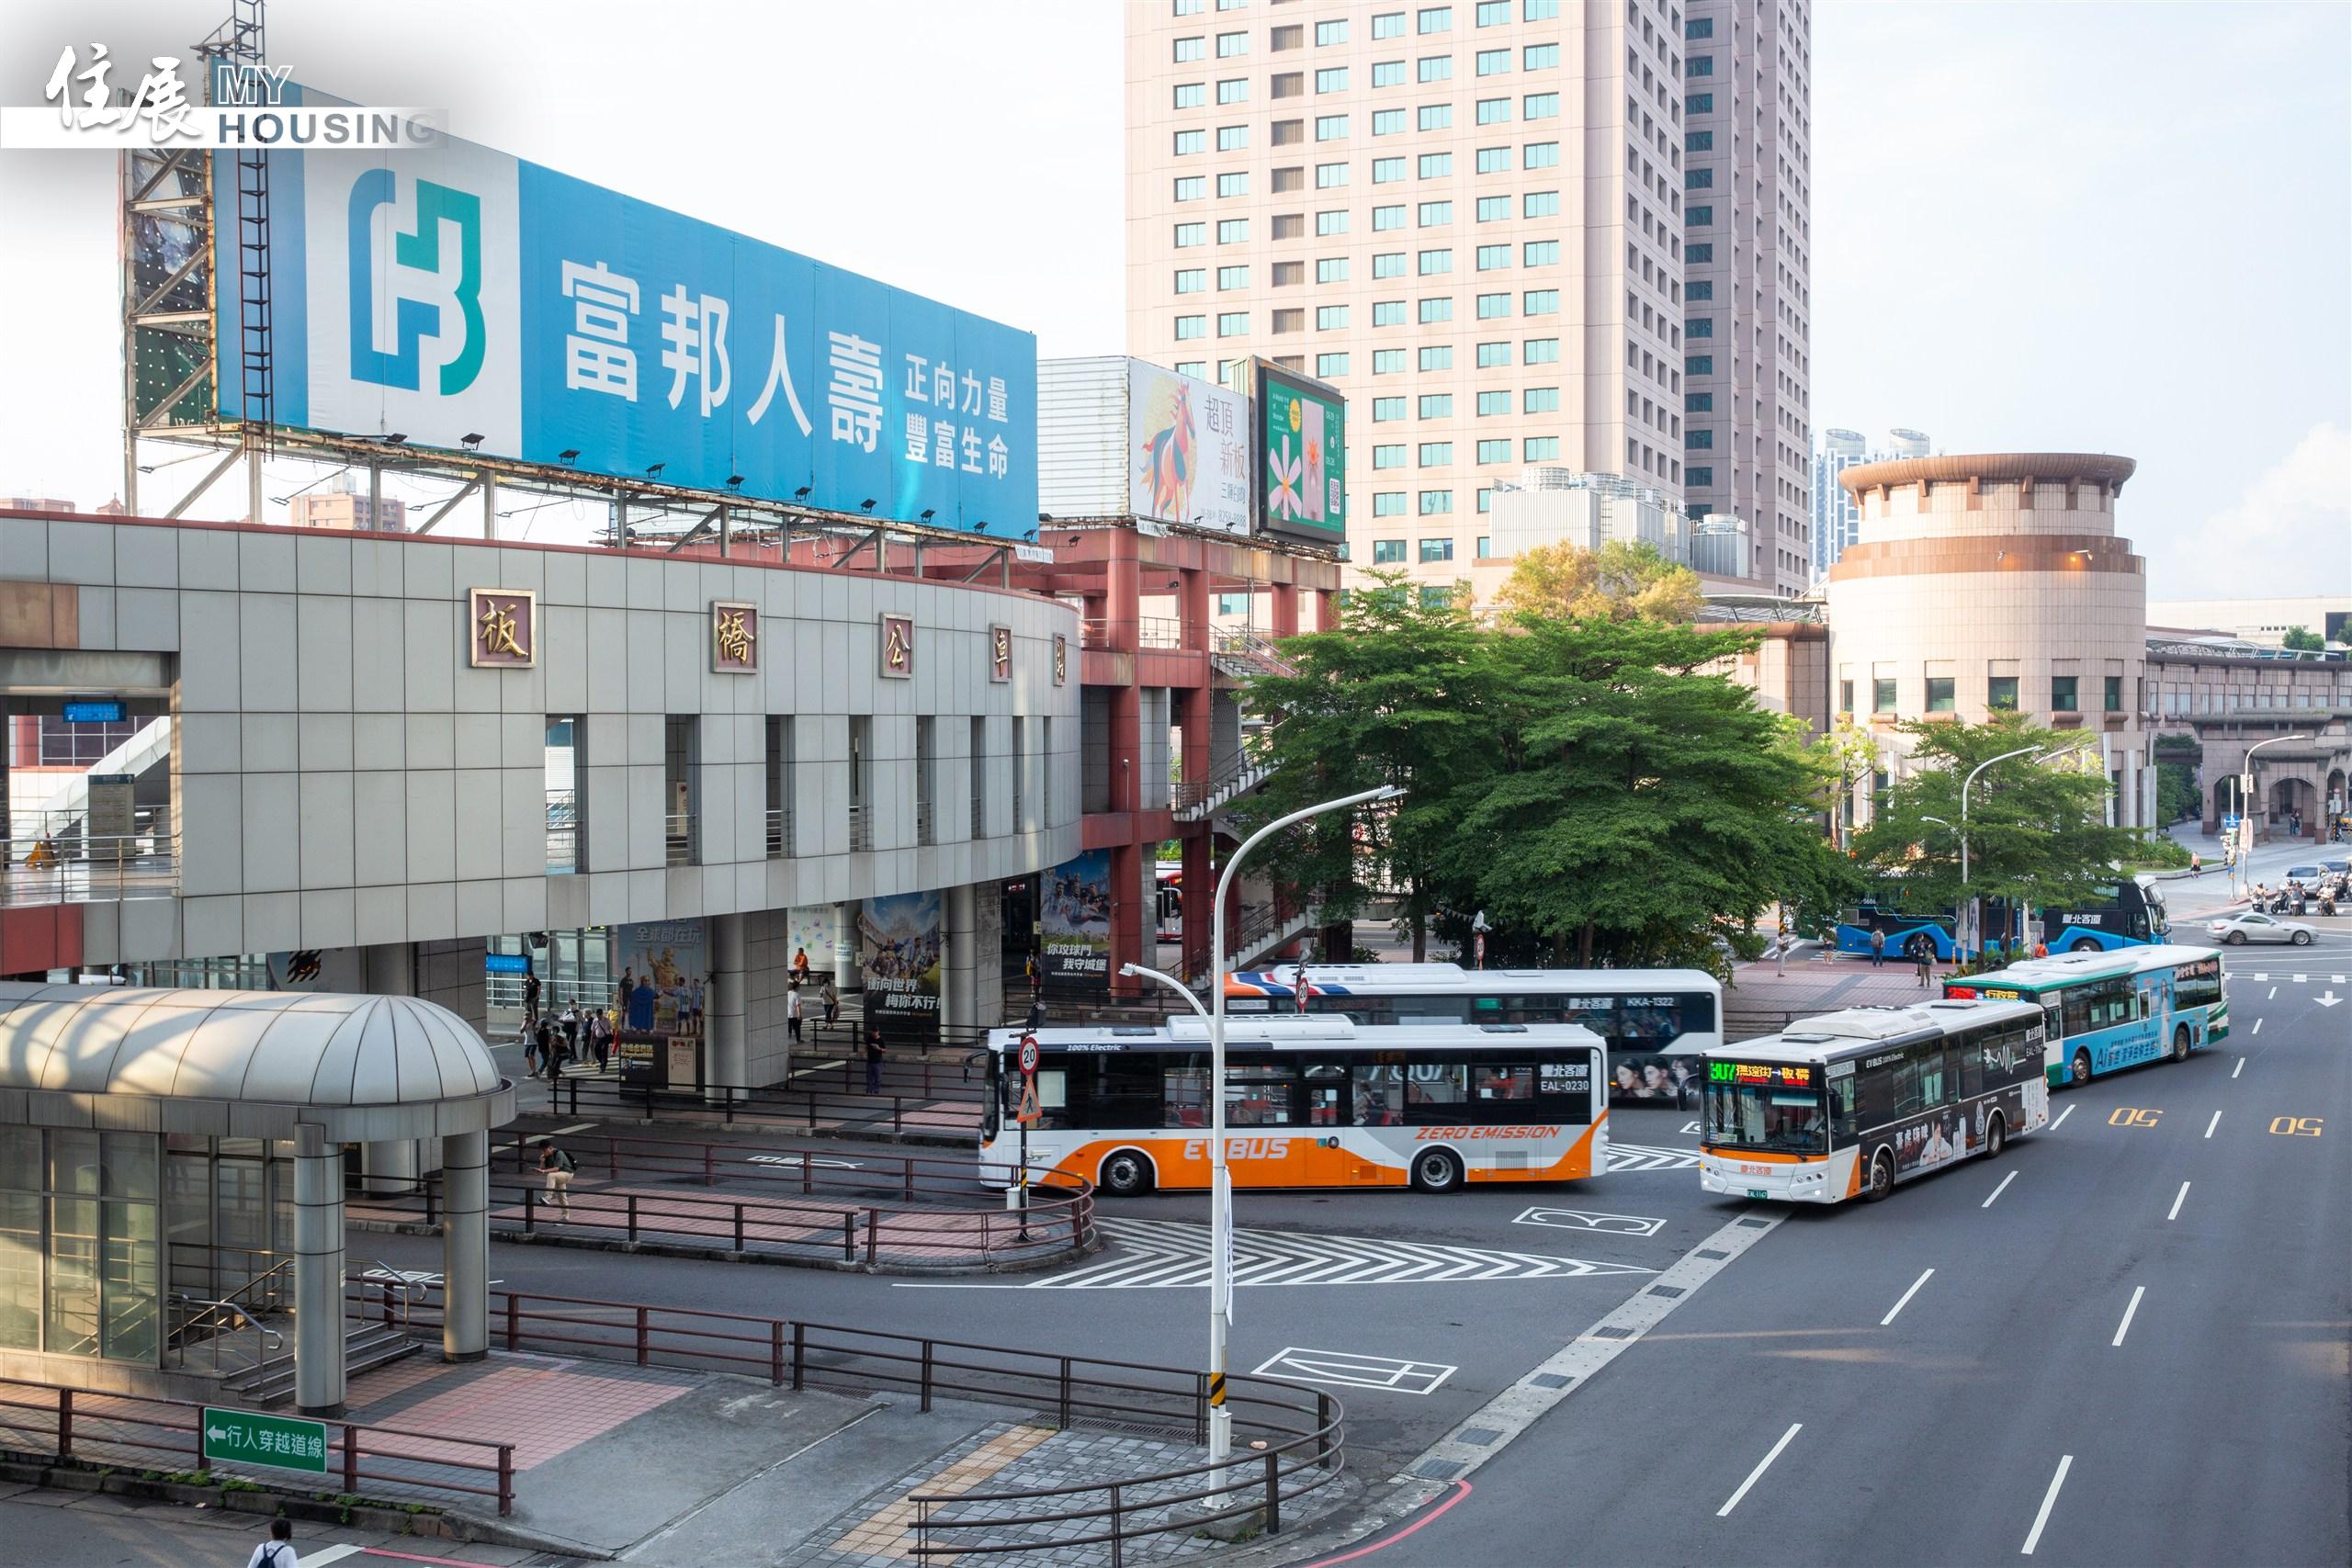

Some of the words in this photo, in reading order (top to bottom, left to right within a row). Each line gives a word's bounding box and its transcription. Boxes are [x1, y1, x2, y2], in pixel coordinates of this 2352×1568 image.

[561, 259, 884, 454] 富邦人壽
[904, 353, 1009, 424] 正向力量
[1204, 393, 1234, 438] 超頂
[905, 411, 1009, 480] 豐富生命
[1047, 943, 1092, 956] 你攻球門
[1062, 957, 1107, 971] 我守城堡
[866, 977, 918, 992] 衝向世界
[1299, 987, 1307, 999] 20
[885, 993, 941, 1010] 梅你不行!
[1626, 997, 1675, 1007] KKA-1322
[1023, 1045, 1036, 1066] 20
[1067, 1043, 1090, 1052] 100%
[1090, 1043, 1122, 1052] Electric
[1540, 1064, 1589, 1078] 臺北客運
[1710, 1062, 1736, 1081] 307
[1540, 1080, 1589, 1092] EAL-0230
[2108, 1107, 2164, 1128] 50
[2268, 1116, 2324, 1137] 50
[1415, 1126, 1470, 1140] ZERO
[1471, 1125, 1562, 1139] EMISSION
[1227, 1138, 1291, 1160] BUS
[226, 1424, 324, 1461] 行人穿越道線
